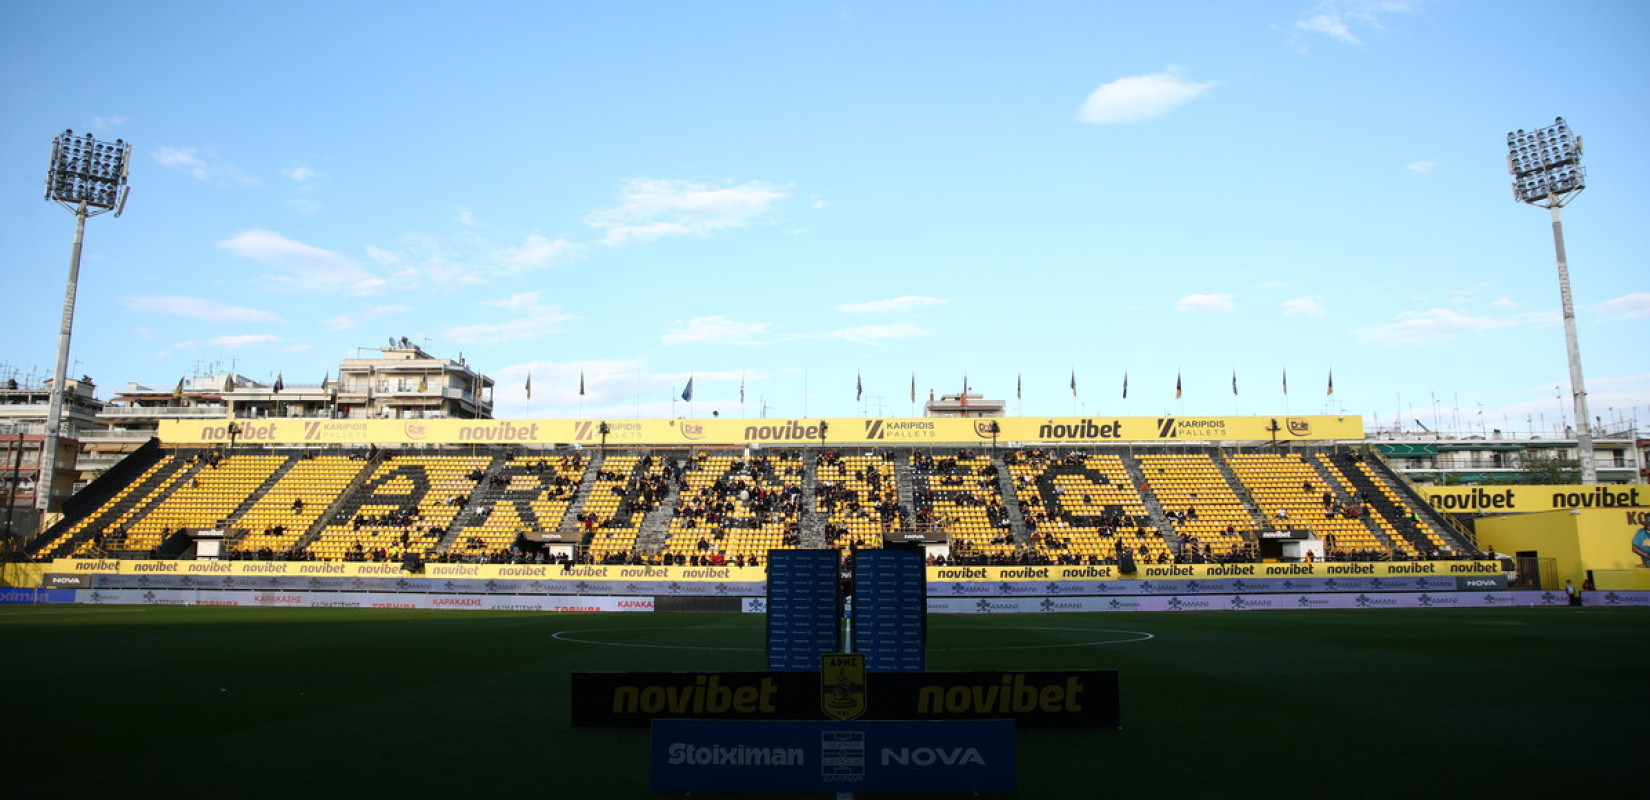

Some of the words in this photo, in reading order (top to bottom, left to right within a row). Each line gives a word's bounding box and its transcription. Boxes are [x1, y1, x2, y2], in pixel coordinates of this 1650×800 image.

[744, 420, 827, 440] novibet
[886, 421, 935, 430] KARIPIDIS
[1039, 419, 1122, 438] novibet
[1178, 420, 1226, 429] KARIPIDIS
[201, 422, 277, 440] noibet
[459, 421, 538, 440] novibet
[1429, 488, 1515, 510] novibet
[1553, 487, 1639, 507] novibet
[75, 560, 120, 570] novibet
[134, 561, 178, 571] novibet
[188, 562, 232, 572] novibet
[243, 563, 287, 573] novibet
[300, 563, 345, 573] novibet
[433, 565, 479, 575] novibet
[1146, 565, 1194, 576] novibet
[1207, 564, 1254, 575] novibet
[1266, 564, 1313, 575] novibet
[1327, 563, 1374, 574] novibet
[1388, 563, 1435, 573] novibet
[1451, 562, 1497, 572] novibet
[498, 566, 546, 576] novibet
[683, 567, 730, 578] novibet
[938, 567, 986, 578] novibet
[1000, 567, 1048, 578] novibet
[1062, 567, 1111, 577] novibet
[618, 600, 654, 608] ΚΑΡΑΚΑ
[611, 674, 779, 714] novibet
[917, 674, 1084, 714] novibet
[668, 742, 804, 766] Stoiximan
[881, 747, 986, 766] NOVA
